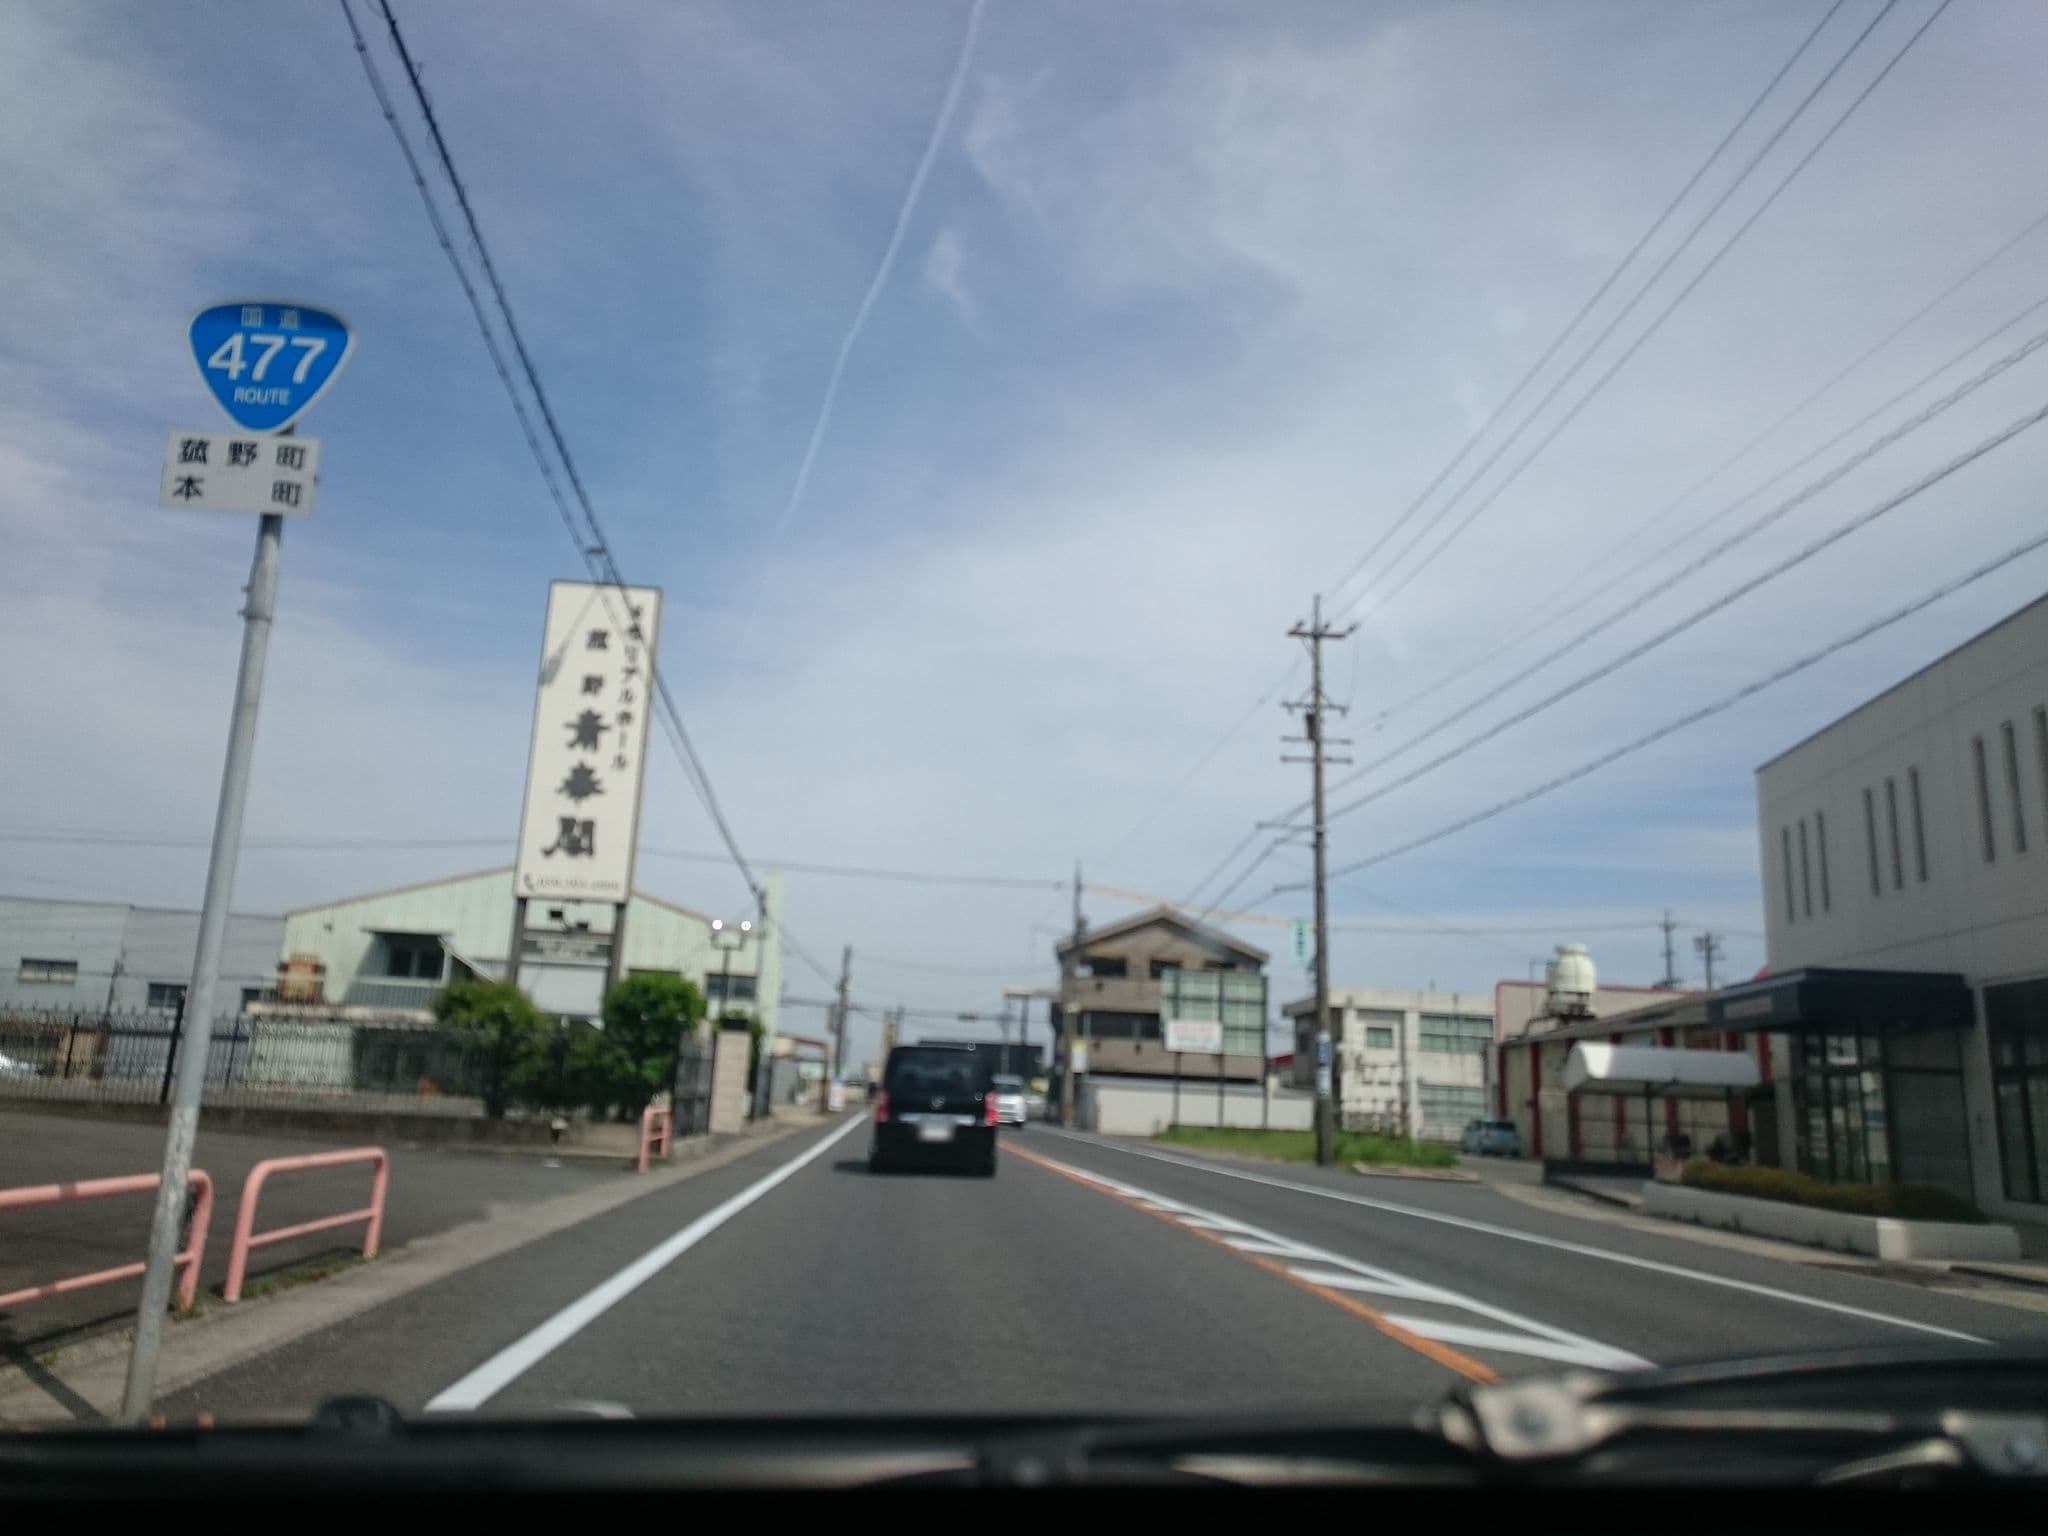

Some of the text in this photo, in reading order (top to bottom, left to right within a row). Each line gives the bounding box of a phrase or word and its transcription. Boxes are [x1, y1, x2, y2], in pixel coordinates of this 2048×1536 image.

[208, 333, 327, 384] 477
[234, 388, 291, 405] ROUTE
[173, 475, 303, 507] 本町
